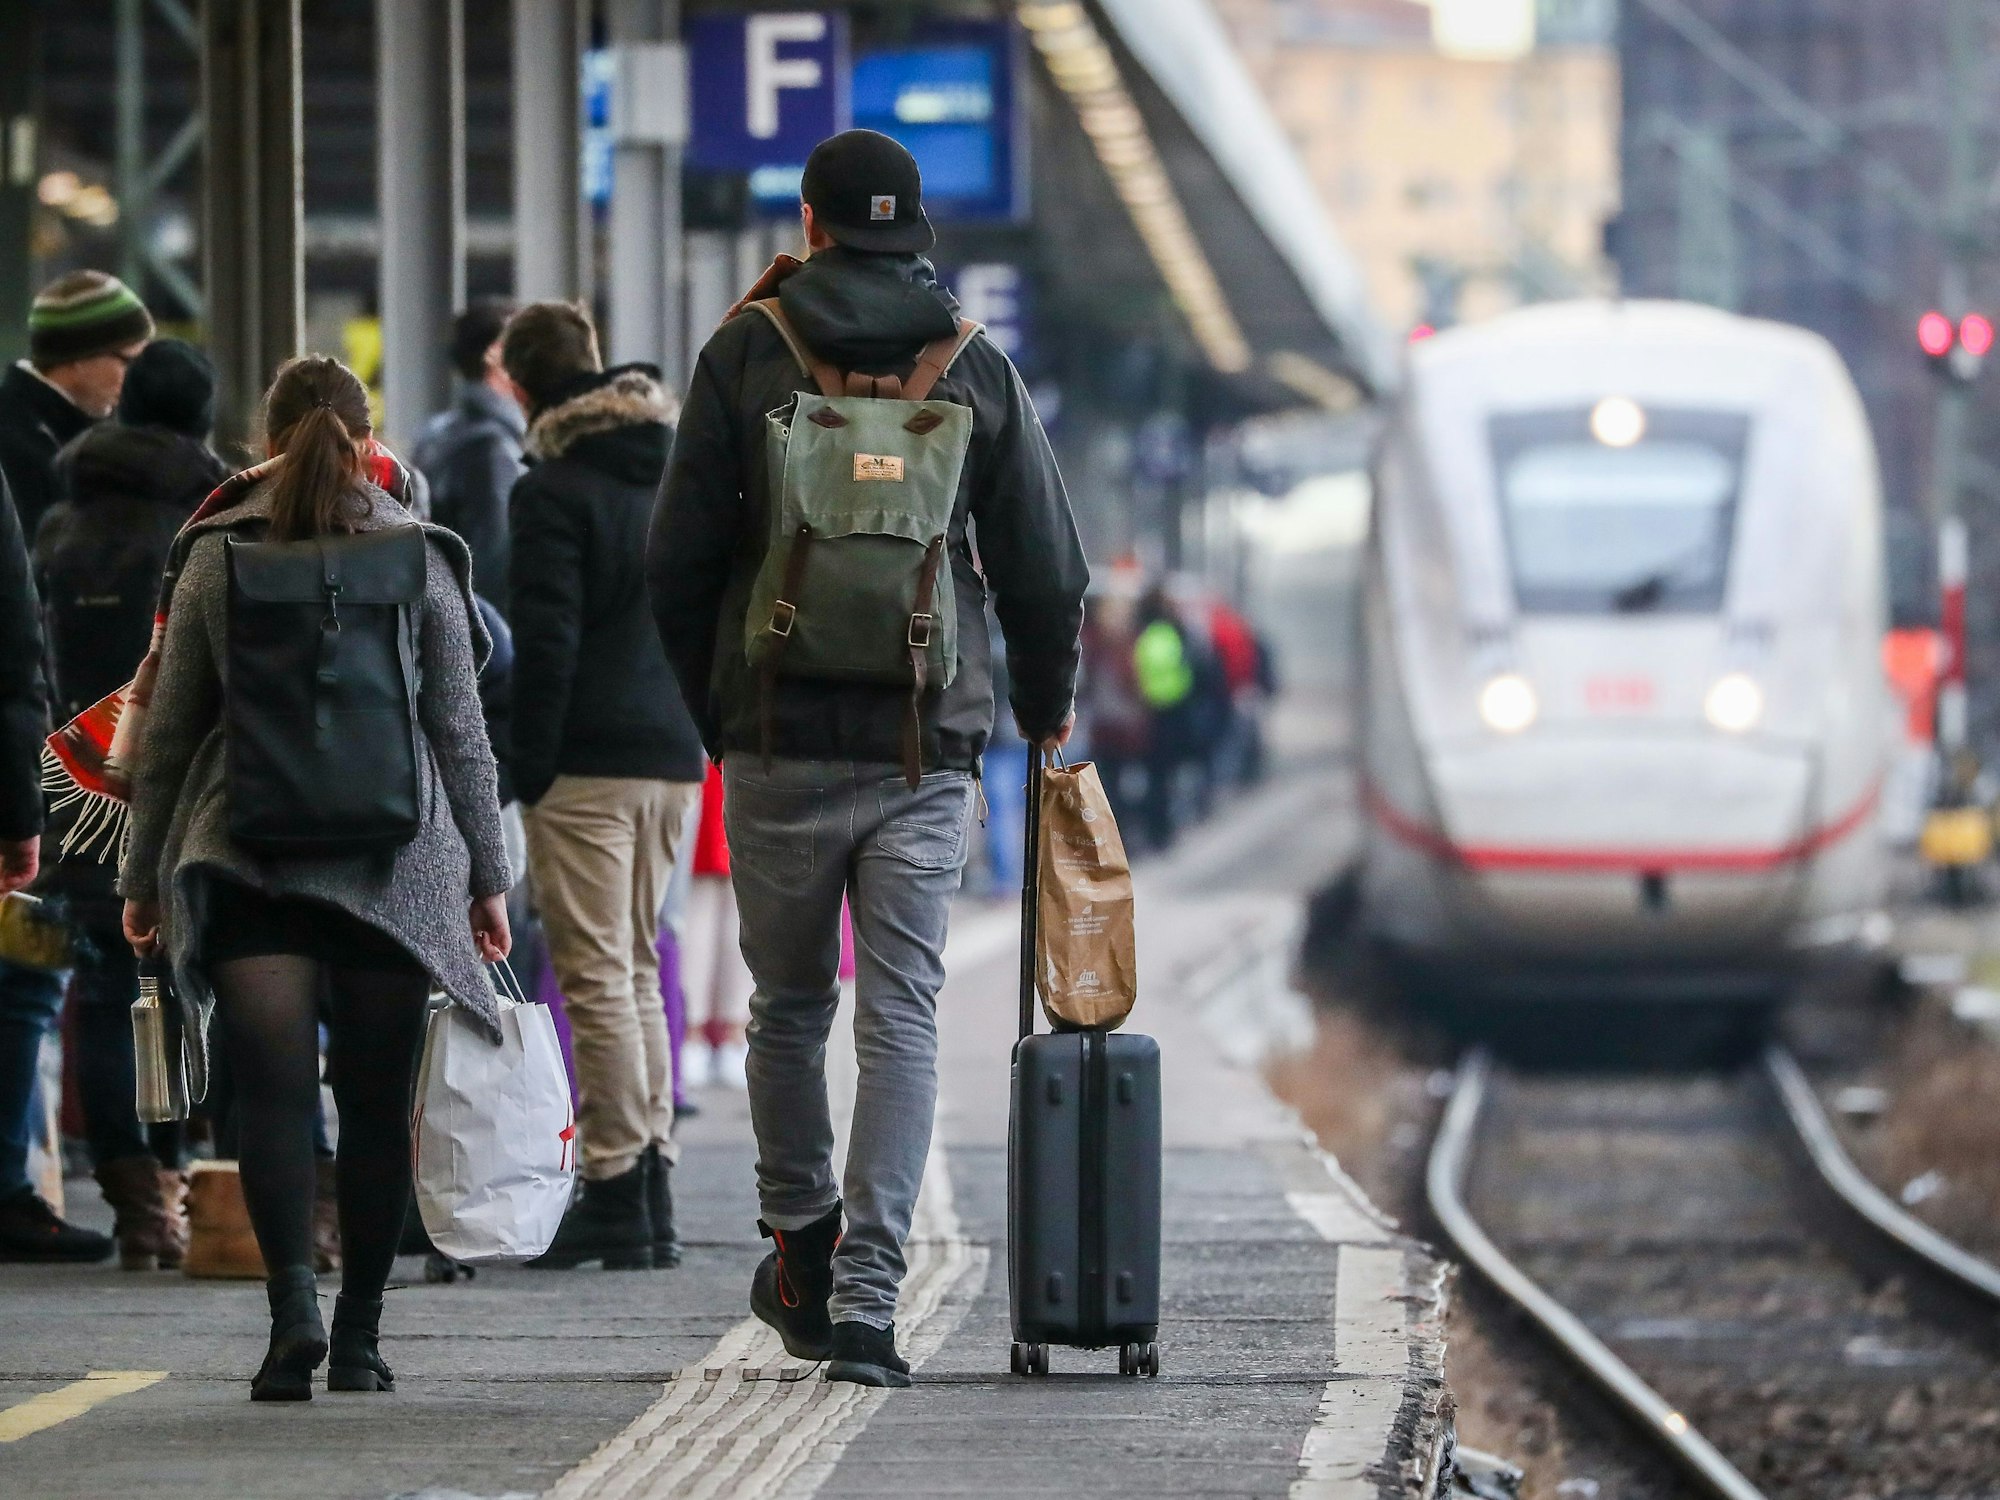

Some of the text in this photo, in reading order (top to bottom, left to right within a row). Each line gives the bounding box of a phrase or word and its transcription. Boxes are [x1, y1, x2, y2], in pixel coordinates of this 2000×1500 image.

[745, 12, 827, 139] F
[957, 263, 1020, 352] E
[1079, 969, 1096, 981] dm
